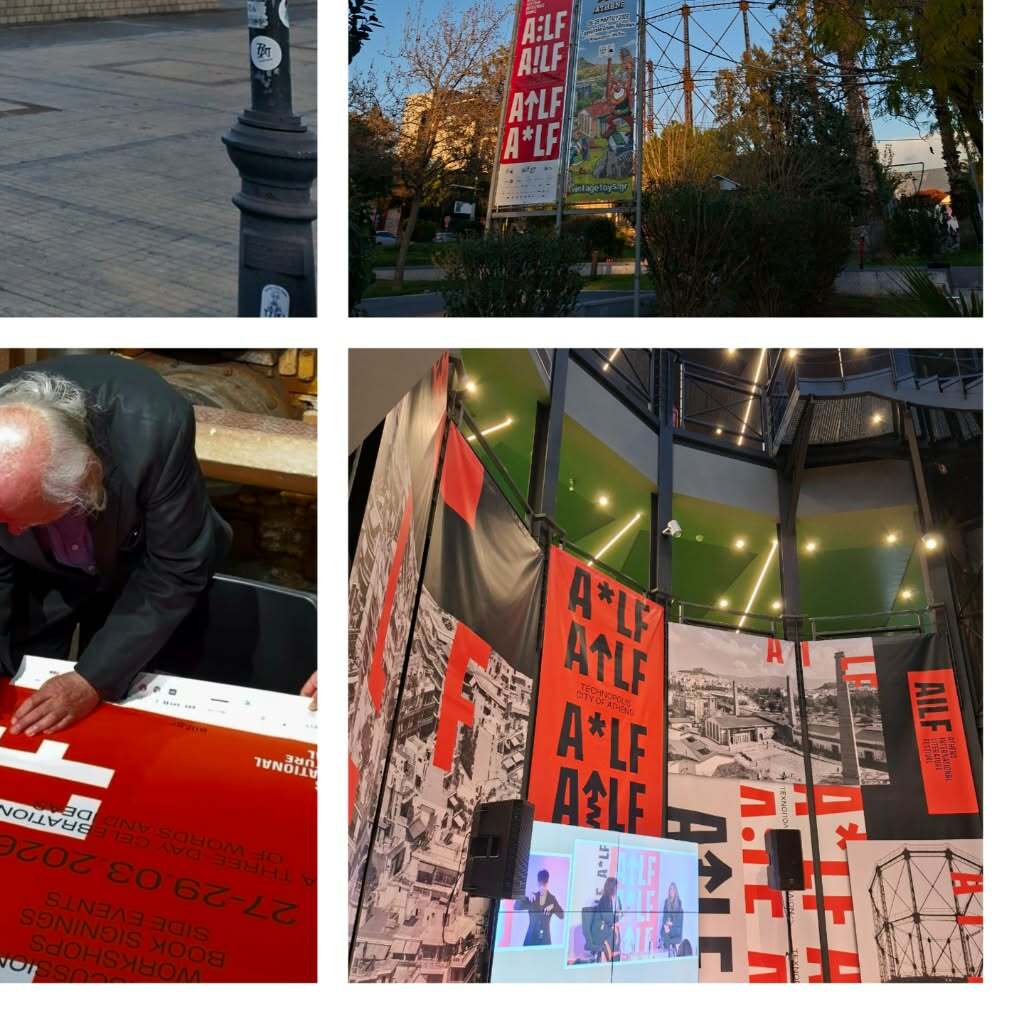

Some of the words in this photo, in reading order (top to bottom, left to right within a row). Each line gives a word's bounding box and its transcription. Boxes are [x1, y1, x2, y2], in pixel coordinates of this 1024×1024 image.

[581, 683, 632, 705] TECHNOPOLIS
[596, 697, 605, 705] OF
[914, 682, 952, 732] AILF
[104, 815, 151, 834] AND
[159, 827, 245, 856] WORDS
[160, 840, 202, 861] DAY
[214, 853, 290, 883] THREE
[256, 849, 284, 864] OF
[45, 890, 145, 928] EVENTS
[19, 907, 143, 949] SIGNINGS
[151, 914, 210, 943] SIDE
[30, 934, 202, 983] WORKSHOPS
[151, 937, 226, 969] BOOK
